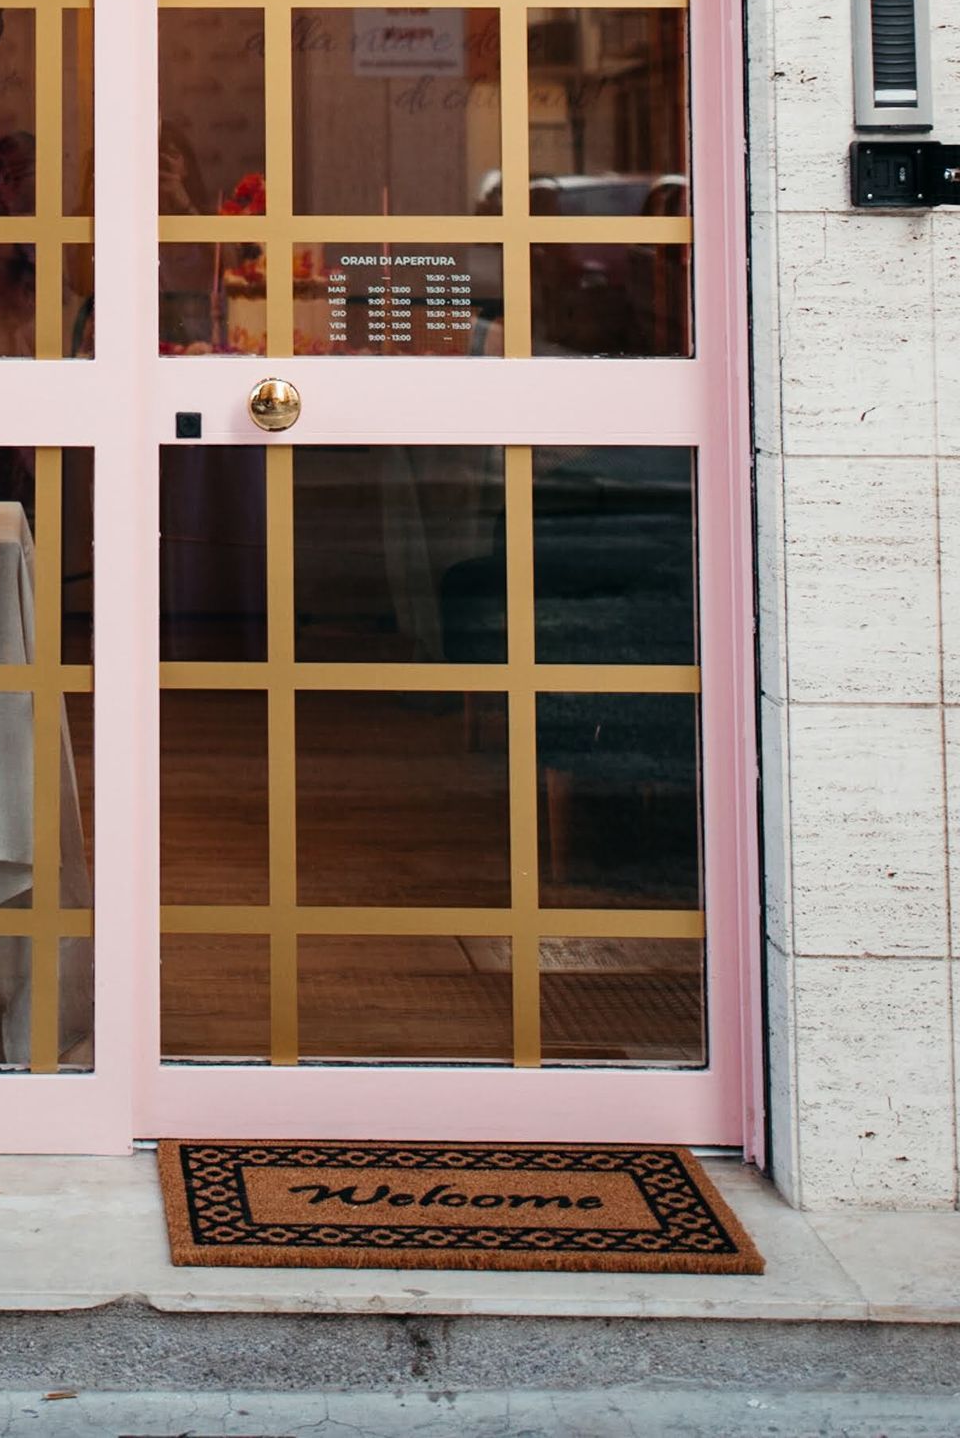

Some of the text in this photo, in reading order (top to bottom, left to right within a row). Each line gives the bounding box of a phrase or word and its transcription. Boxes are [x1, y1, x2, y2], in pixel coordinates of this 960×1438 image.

[341, 257, 456, 265] ORARI DI APERTURA
[290, 1182, 606, 1211] Welcome
